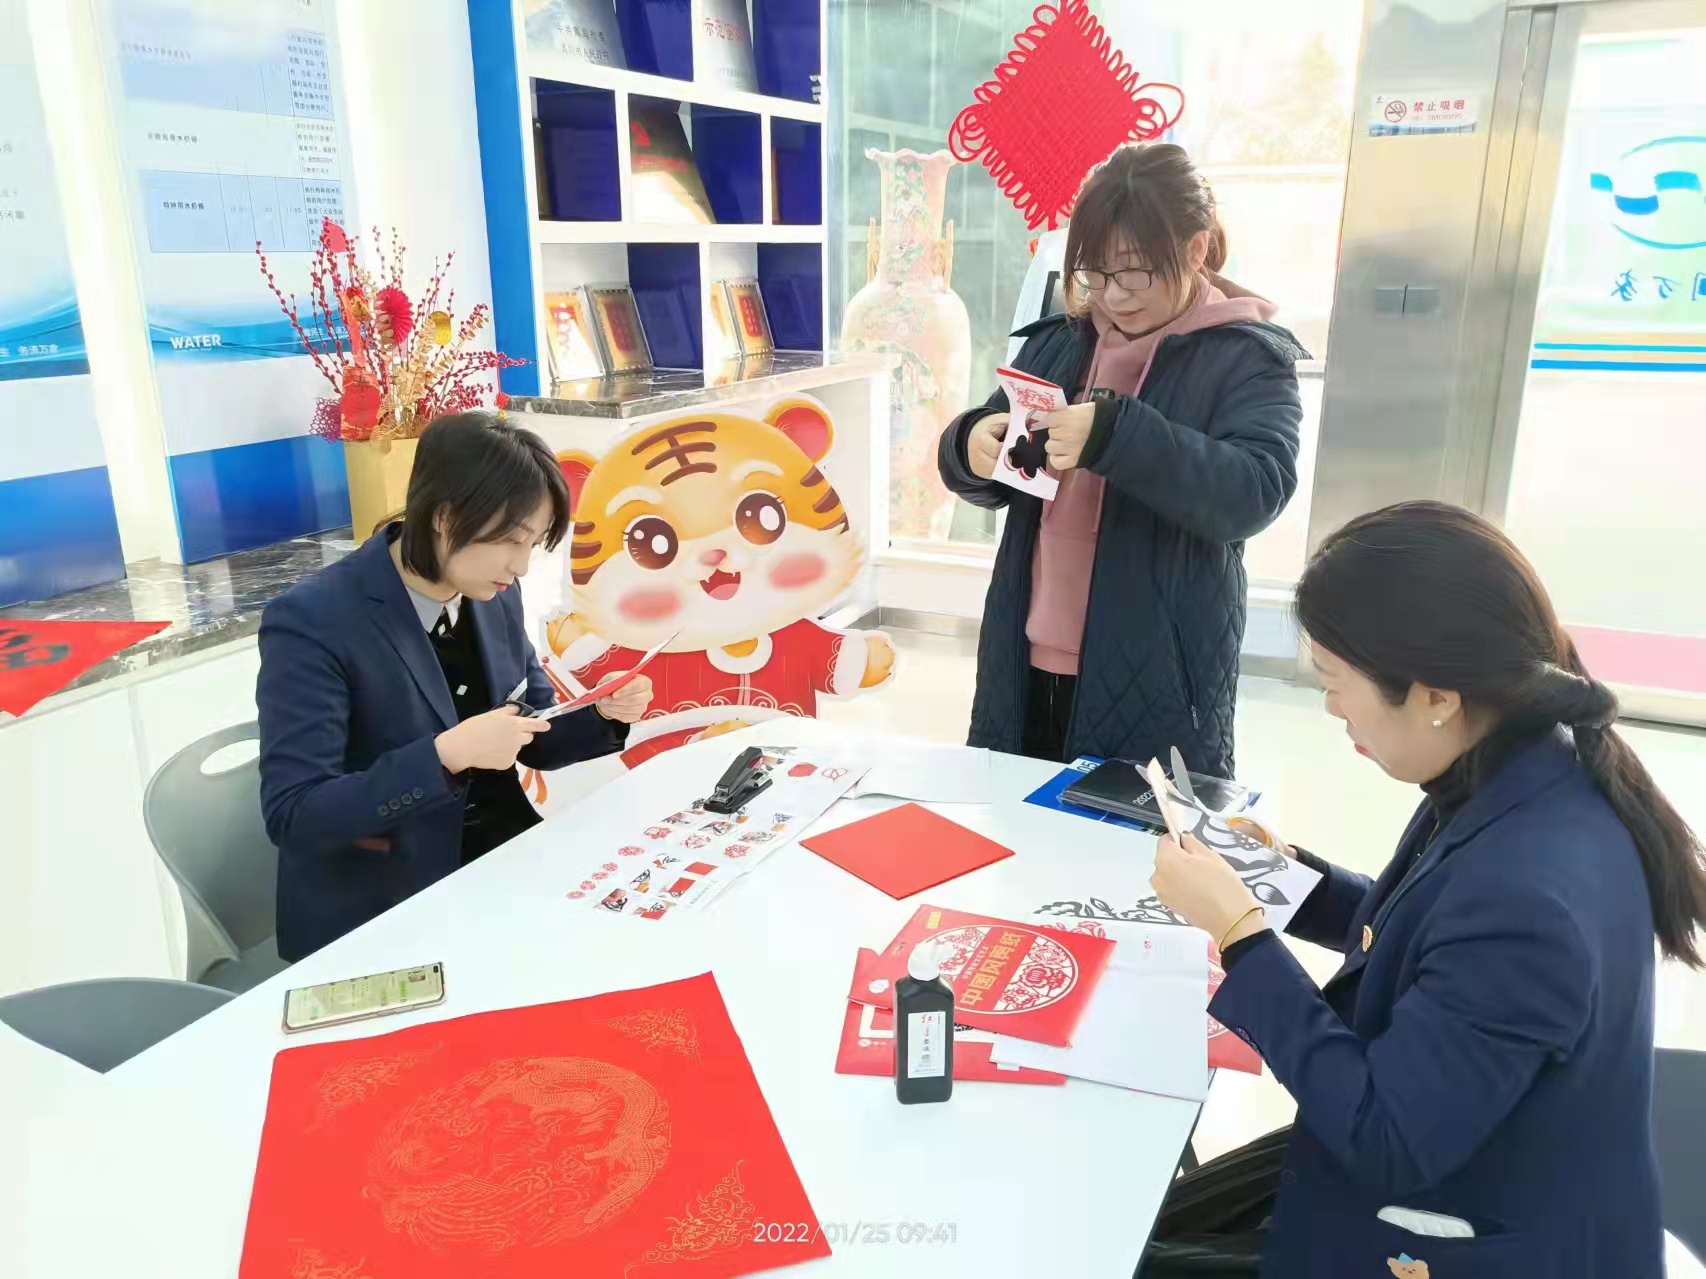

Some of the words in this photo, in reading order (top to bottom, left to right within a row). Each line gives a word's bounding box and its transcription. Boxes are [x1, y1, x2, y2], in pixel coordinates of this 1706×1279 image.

[1413, 98, 1465, 112] 禁止吸烟
[170, 334, 221, 348] WATER
